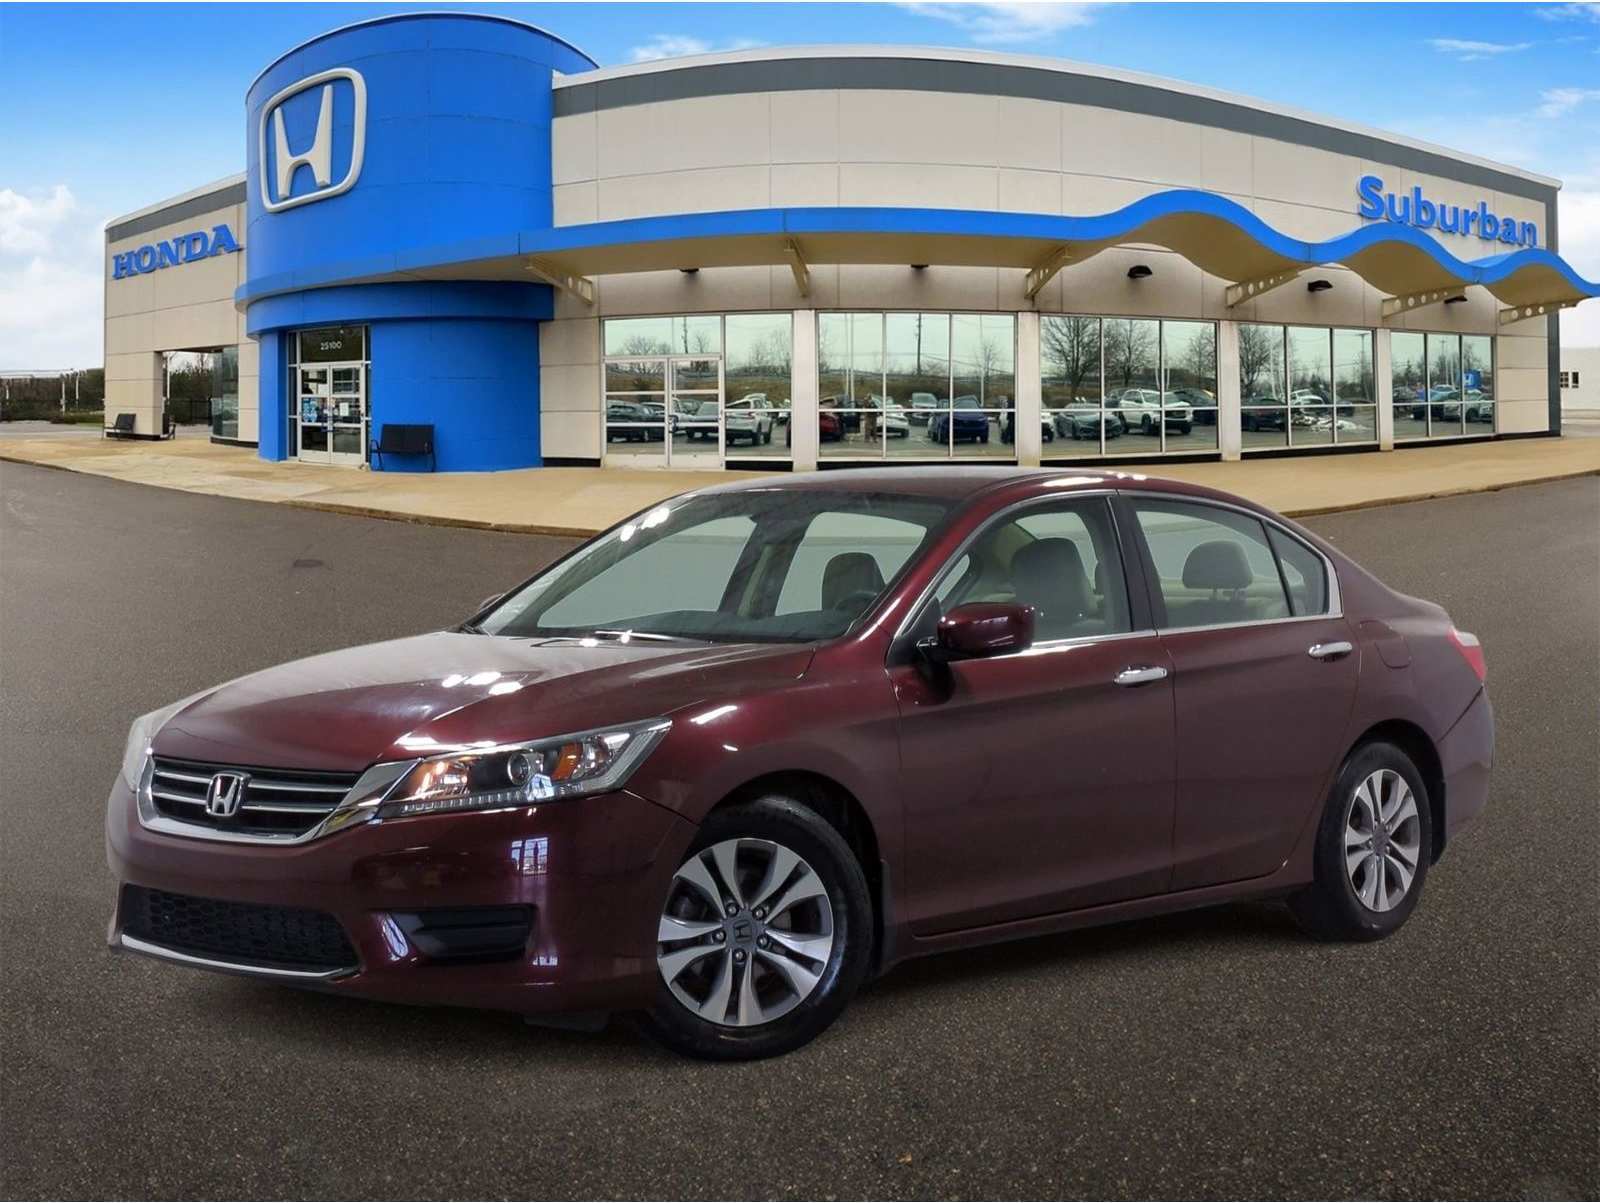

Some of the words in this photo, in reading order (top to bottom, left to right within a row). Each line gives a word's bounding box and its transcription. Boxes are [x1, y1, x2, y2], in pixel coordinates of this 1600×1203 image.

[1358, 175, 1537, 248] Suburban
[112, 223, 241, 280] HONDA
[320, 340, 343, 350] 25100
